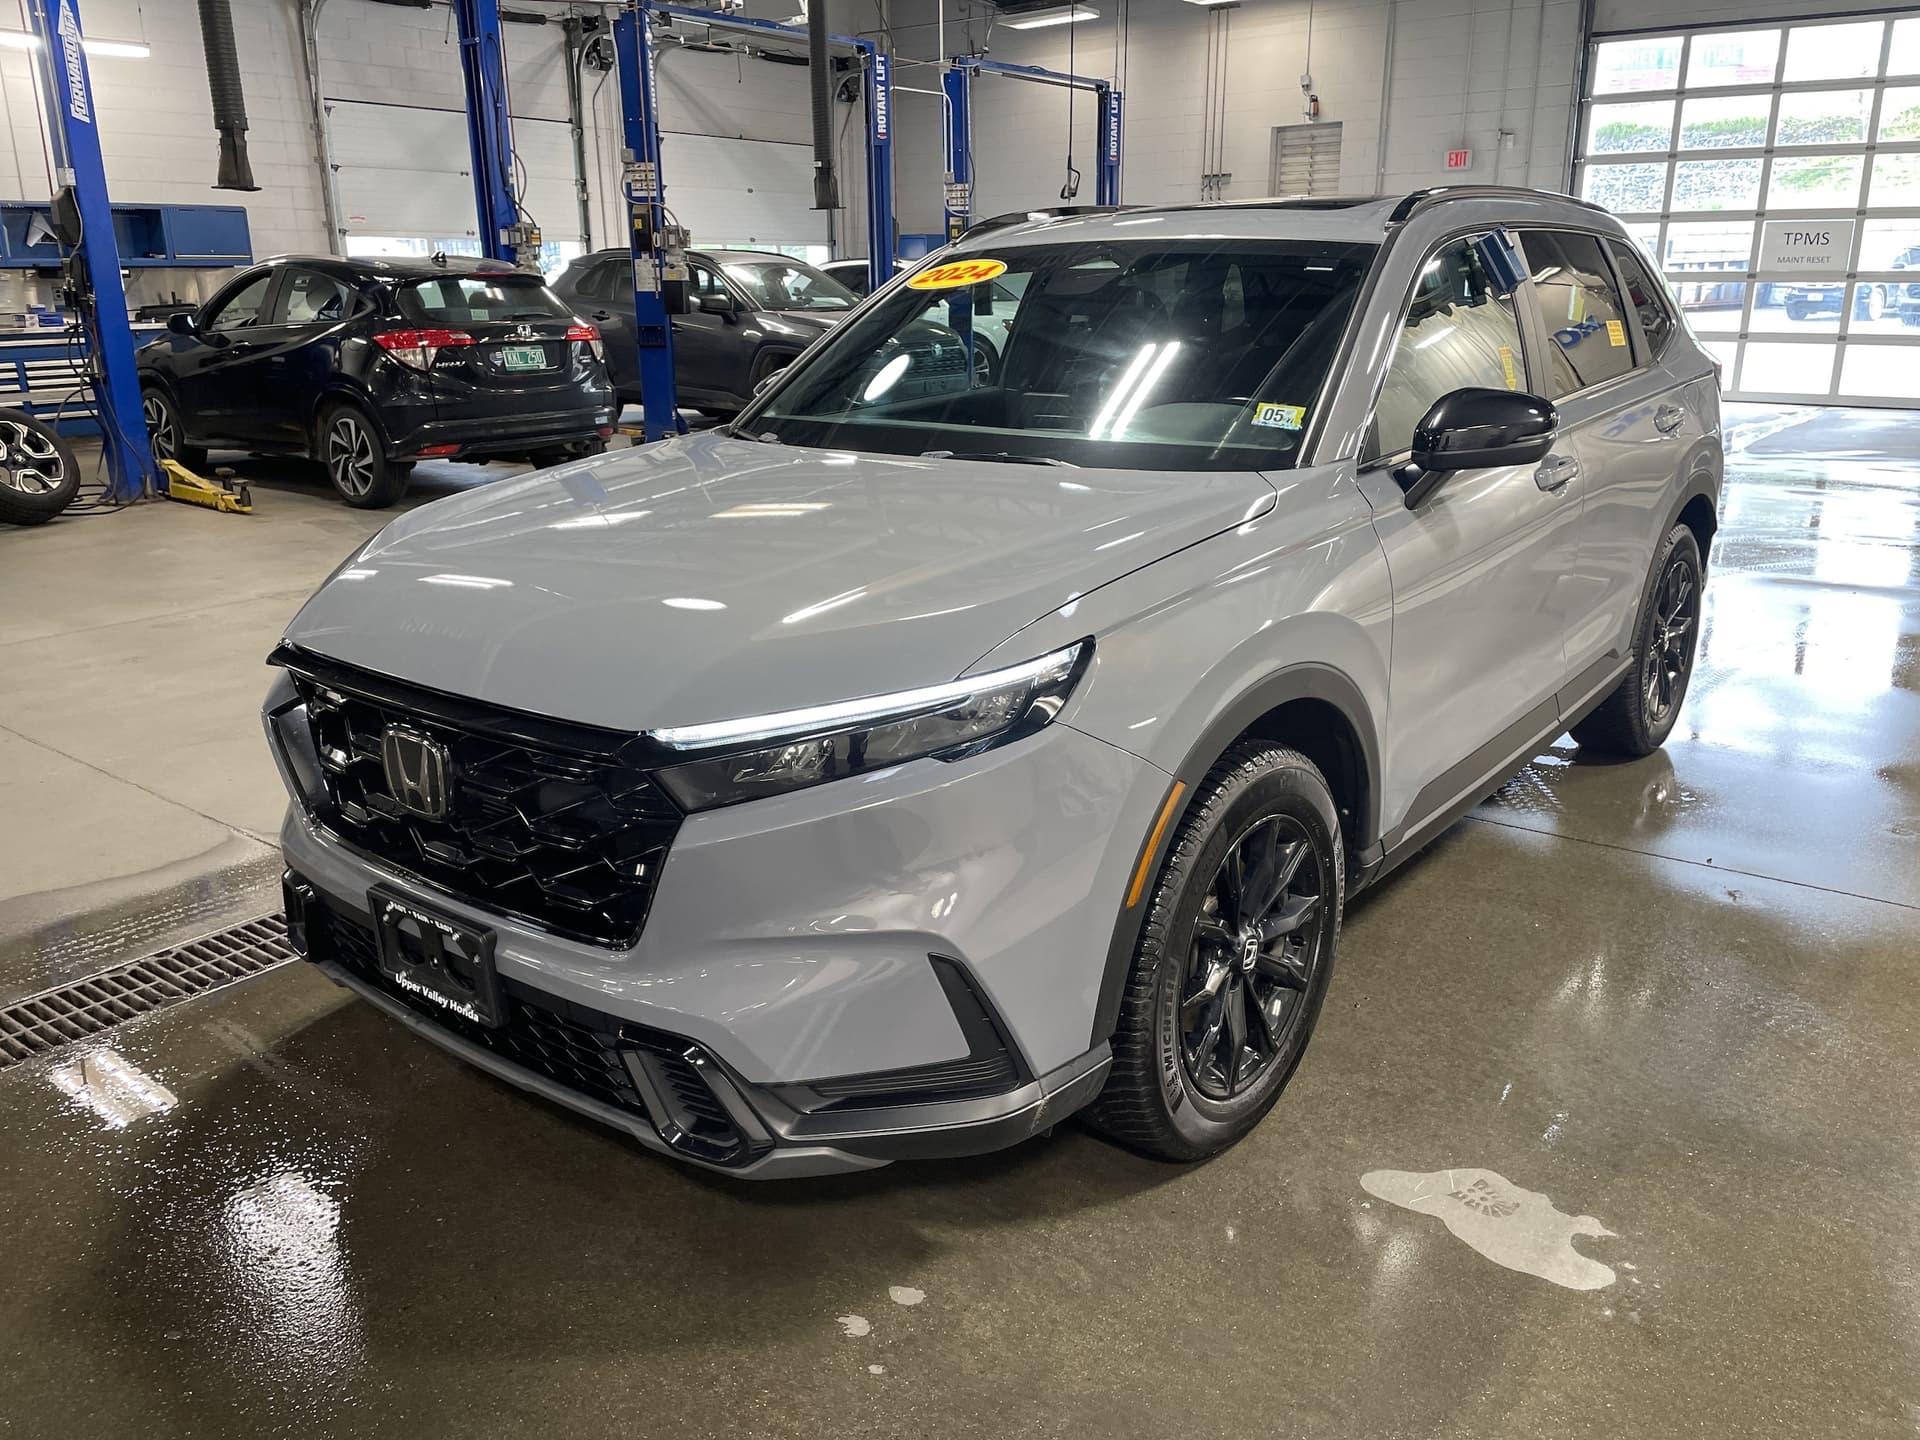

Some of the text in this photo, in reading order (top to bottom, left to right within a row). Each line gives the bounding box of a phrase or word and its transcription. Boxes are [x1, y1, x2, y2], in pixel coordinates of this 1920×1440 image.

[875, 54, 887, 133] ROTARY LIFT
[1110, 93, 1119, 156] ROTARY LIFT
[1448, 151, 1468, 168] EXIT
[1783, 231, 1830, 246] TPMS
[1777, 255, 1832, 264] MAINT RESET
[912, 264, 1001, 285] 2024
[507, 351, 543, 365] KKL 250
[1263, 408, 1285, 422] 05
[395, 973, 480, 1022] Upper Valley Honda
